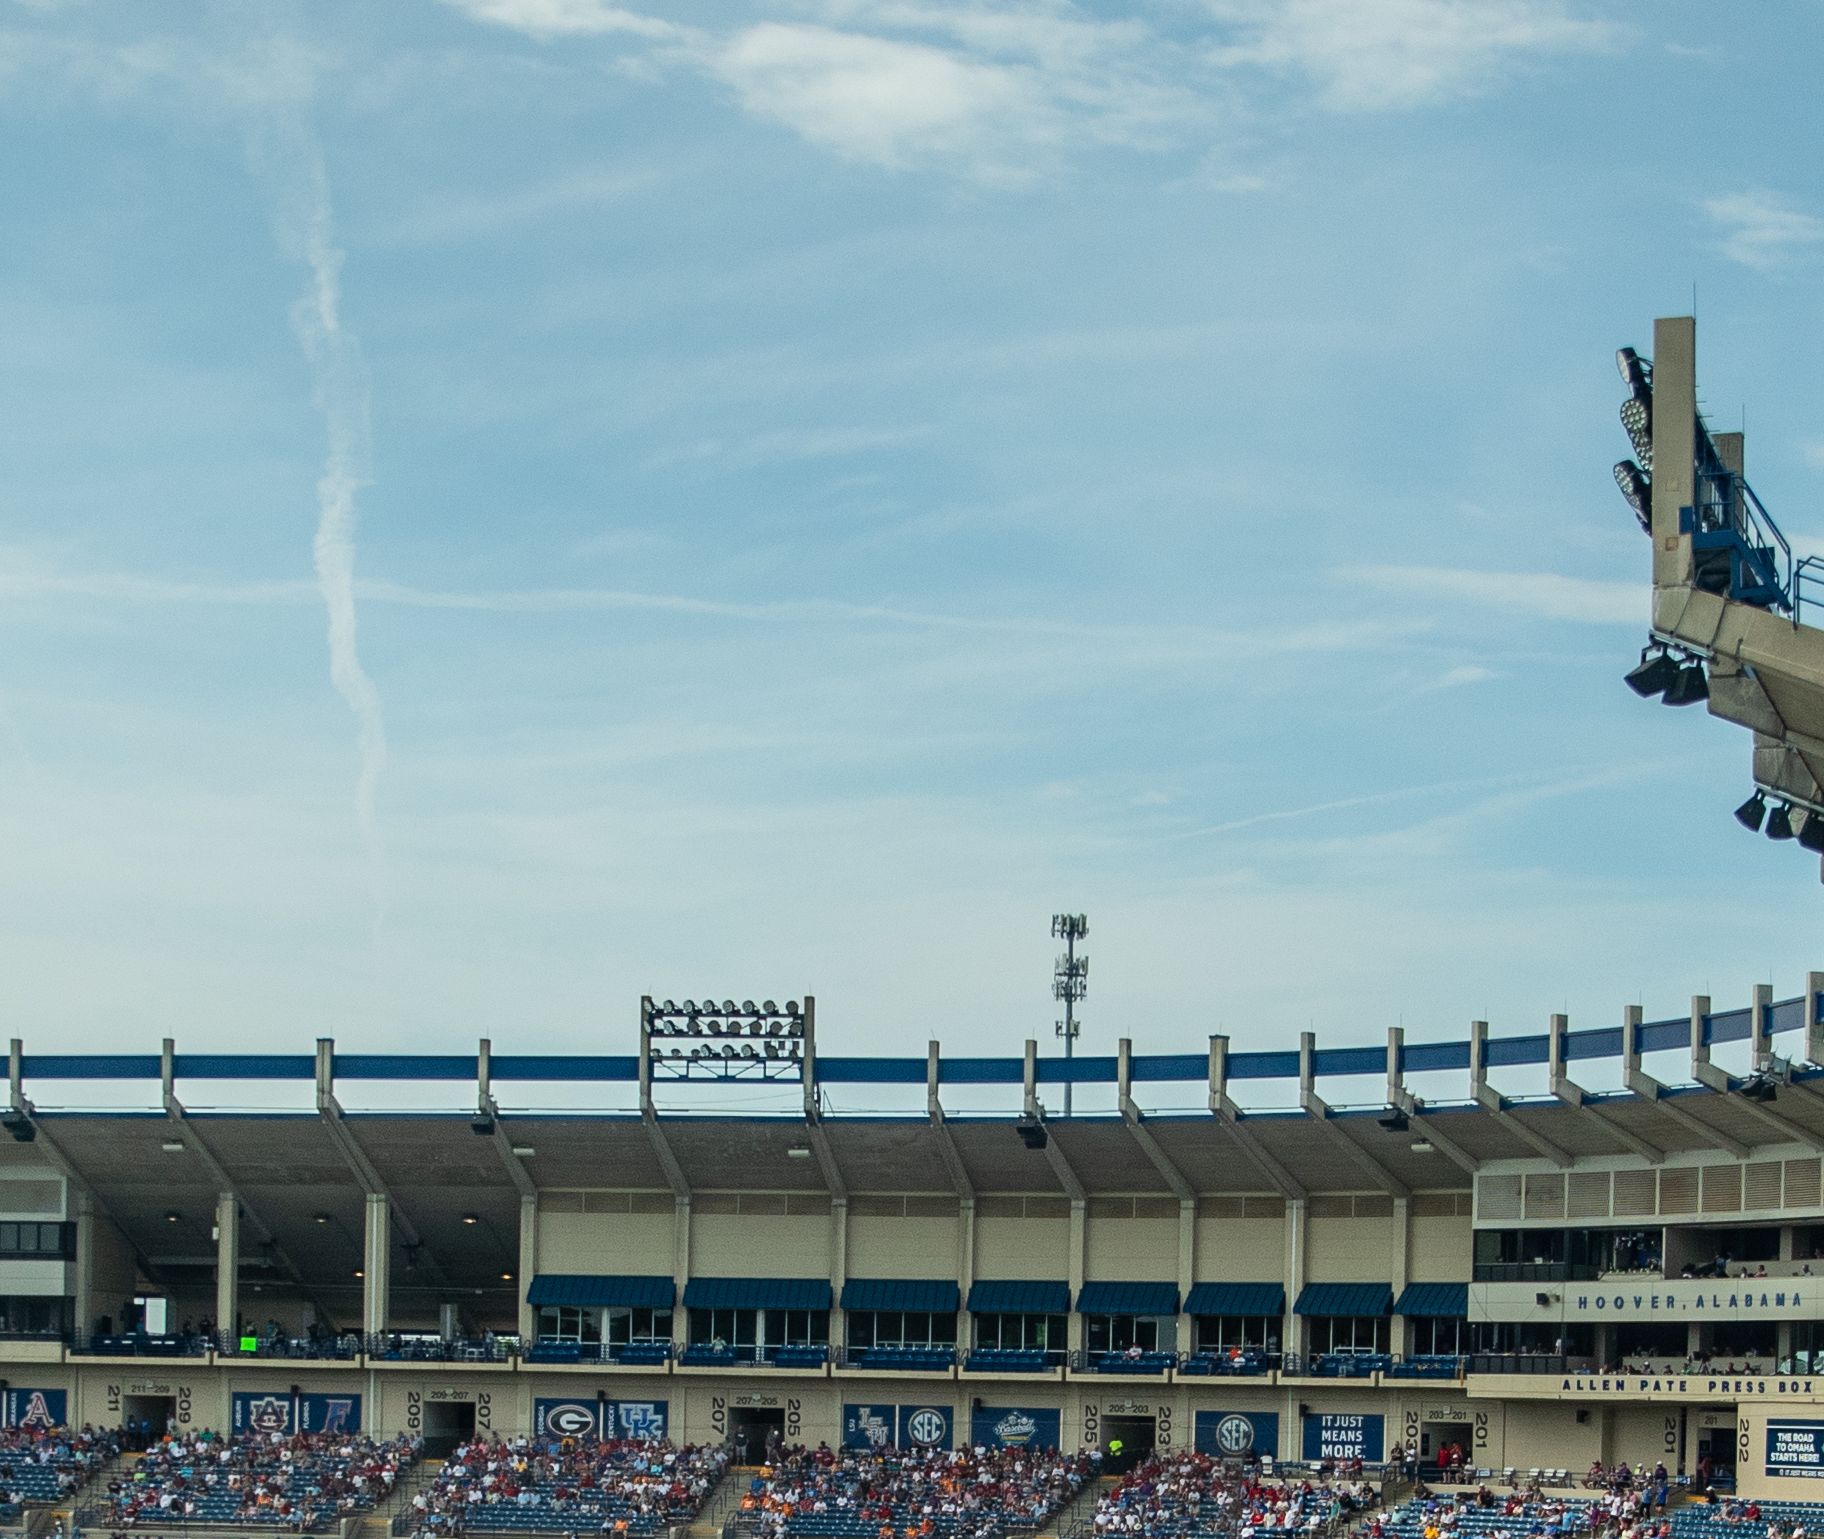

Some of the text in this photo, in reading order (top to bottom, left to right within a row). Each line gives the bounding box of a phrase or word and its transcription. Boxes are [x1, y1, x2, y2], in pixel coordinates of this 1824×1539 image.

[1696, 1292, 1801, 1308] ALABAMA
[108, 1385, 121, 1412] 211
[1562, 1379, 1813, 1393] ALLEN PATE PRESS BOX
[179, 1387, 191, 1424] 209
[407, 1391, 421, 1429] 209
[478, 1393, 491, 1430] 207
[712, 1397, 725, 1435] 207
[787, 1399, 801, 1437] 205
[1322, 1415, 1364, 1427] IT JUST
[1704, 1415, 1718, 1425] 201
[912, 1412, 943, 1442] SEC
[1085, 1405, 1098, 1443] 205
[1158, 1406, 1171, 1446] 203
[1219, 1418, 1250, 1450] SEC
[1321, 1430, 1363, 1442] MEANS
[1475, 1412, 1489, 1448] 201
[1664, 1416, 1676, 1453] 201
[1777, 1432, 1814, 1442] THE ROAD
[1739, 1418, 1750, 1463] 202
[1776, 1442, 1787, 1452] TO
[1787, 1443, 1815, 1452] OMAHA
[1770, 1452, 1820, 1463] STARTS HERE!
